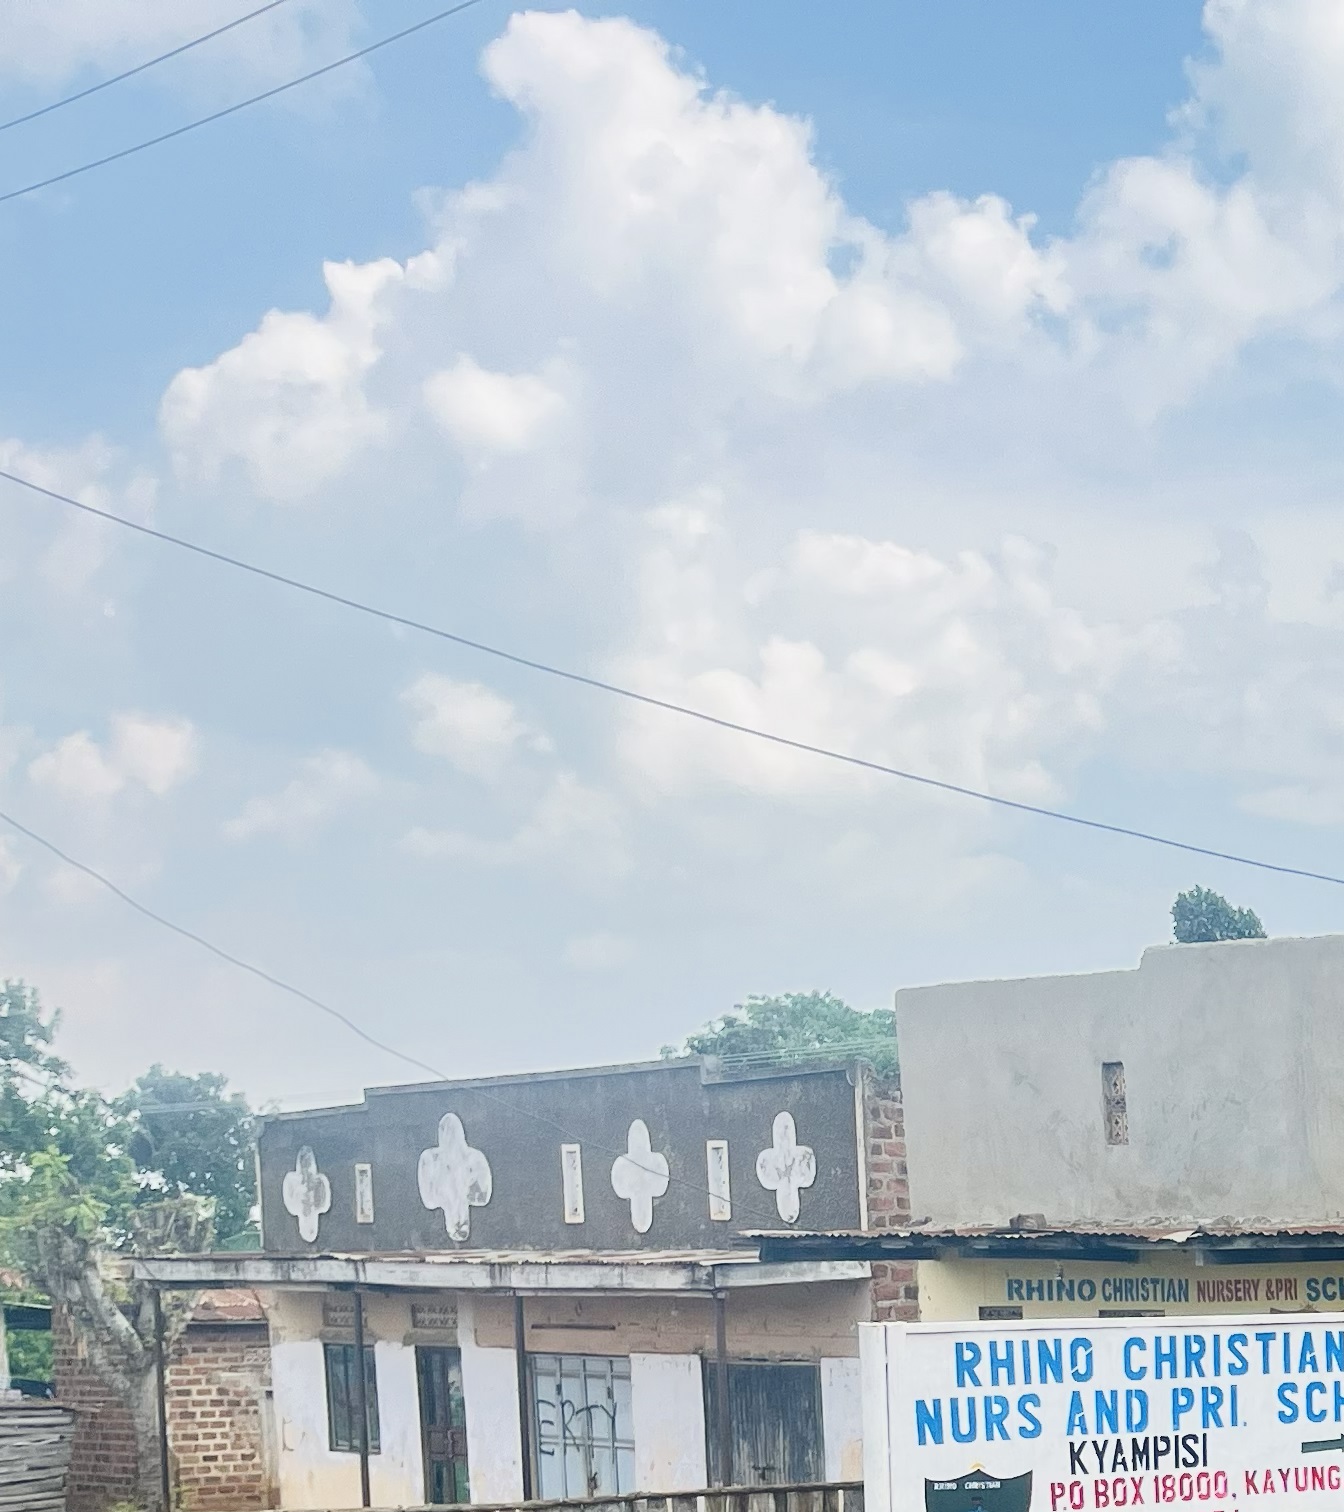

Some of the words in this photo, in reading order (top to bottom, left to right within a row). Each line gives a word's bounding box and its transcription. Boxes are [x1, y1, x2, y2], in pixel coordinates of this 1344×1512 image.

[1006, 1278, 1097, 1302] RHINO
[1102, 1277, 1190, 1303] CHRISTIAN
[1196, 1278, 1261, 1303] NURSERY
[955, 1337, 1094, 1388] RHINO
[915, 1393, 1043, 1446] NURS
[1066, 1389, 1149, 1436] AND
[1069, 1432, 1209, 1476] KYAMPISI
[1094, 1476, 1145, 1509] BOX
